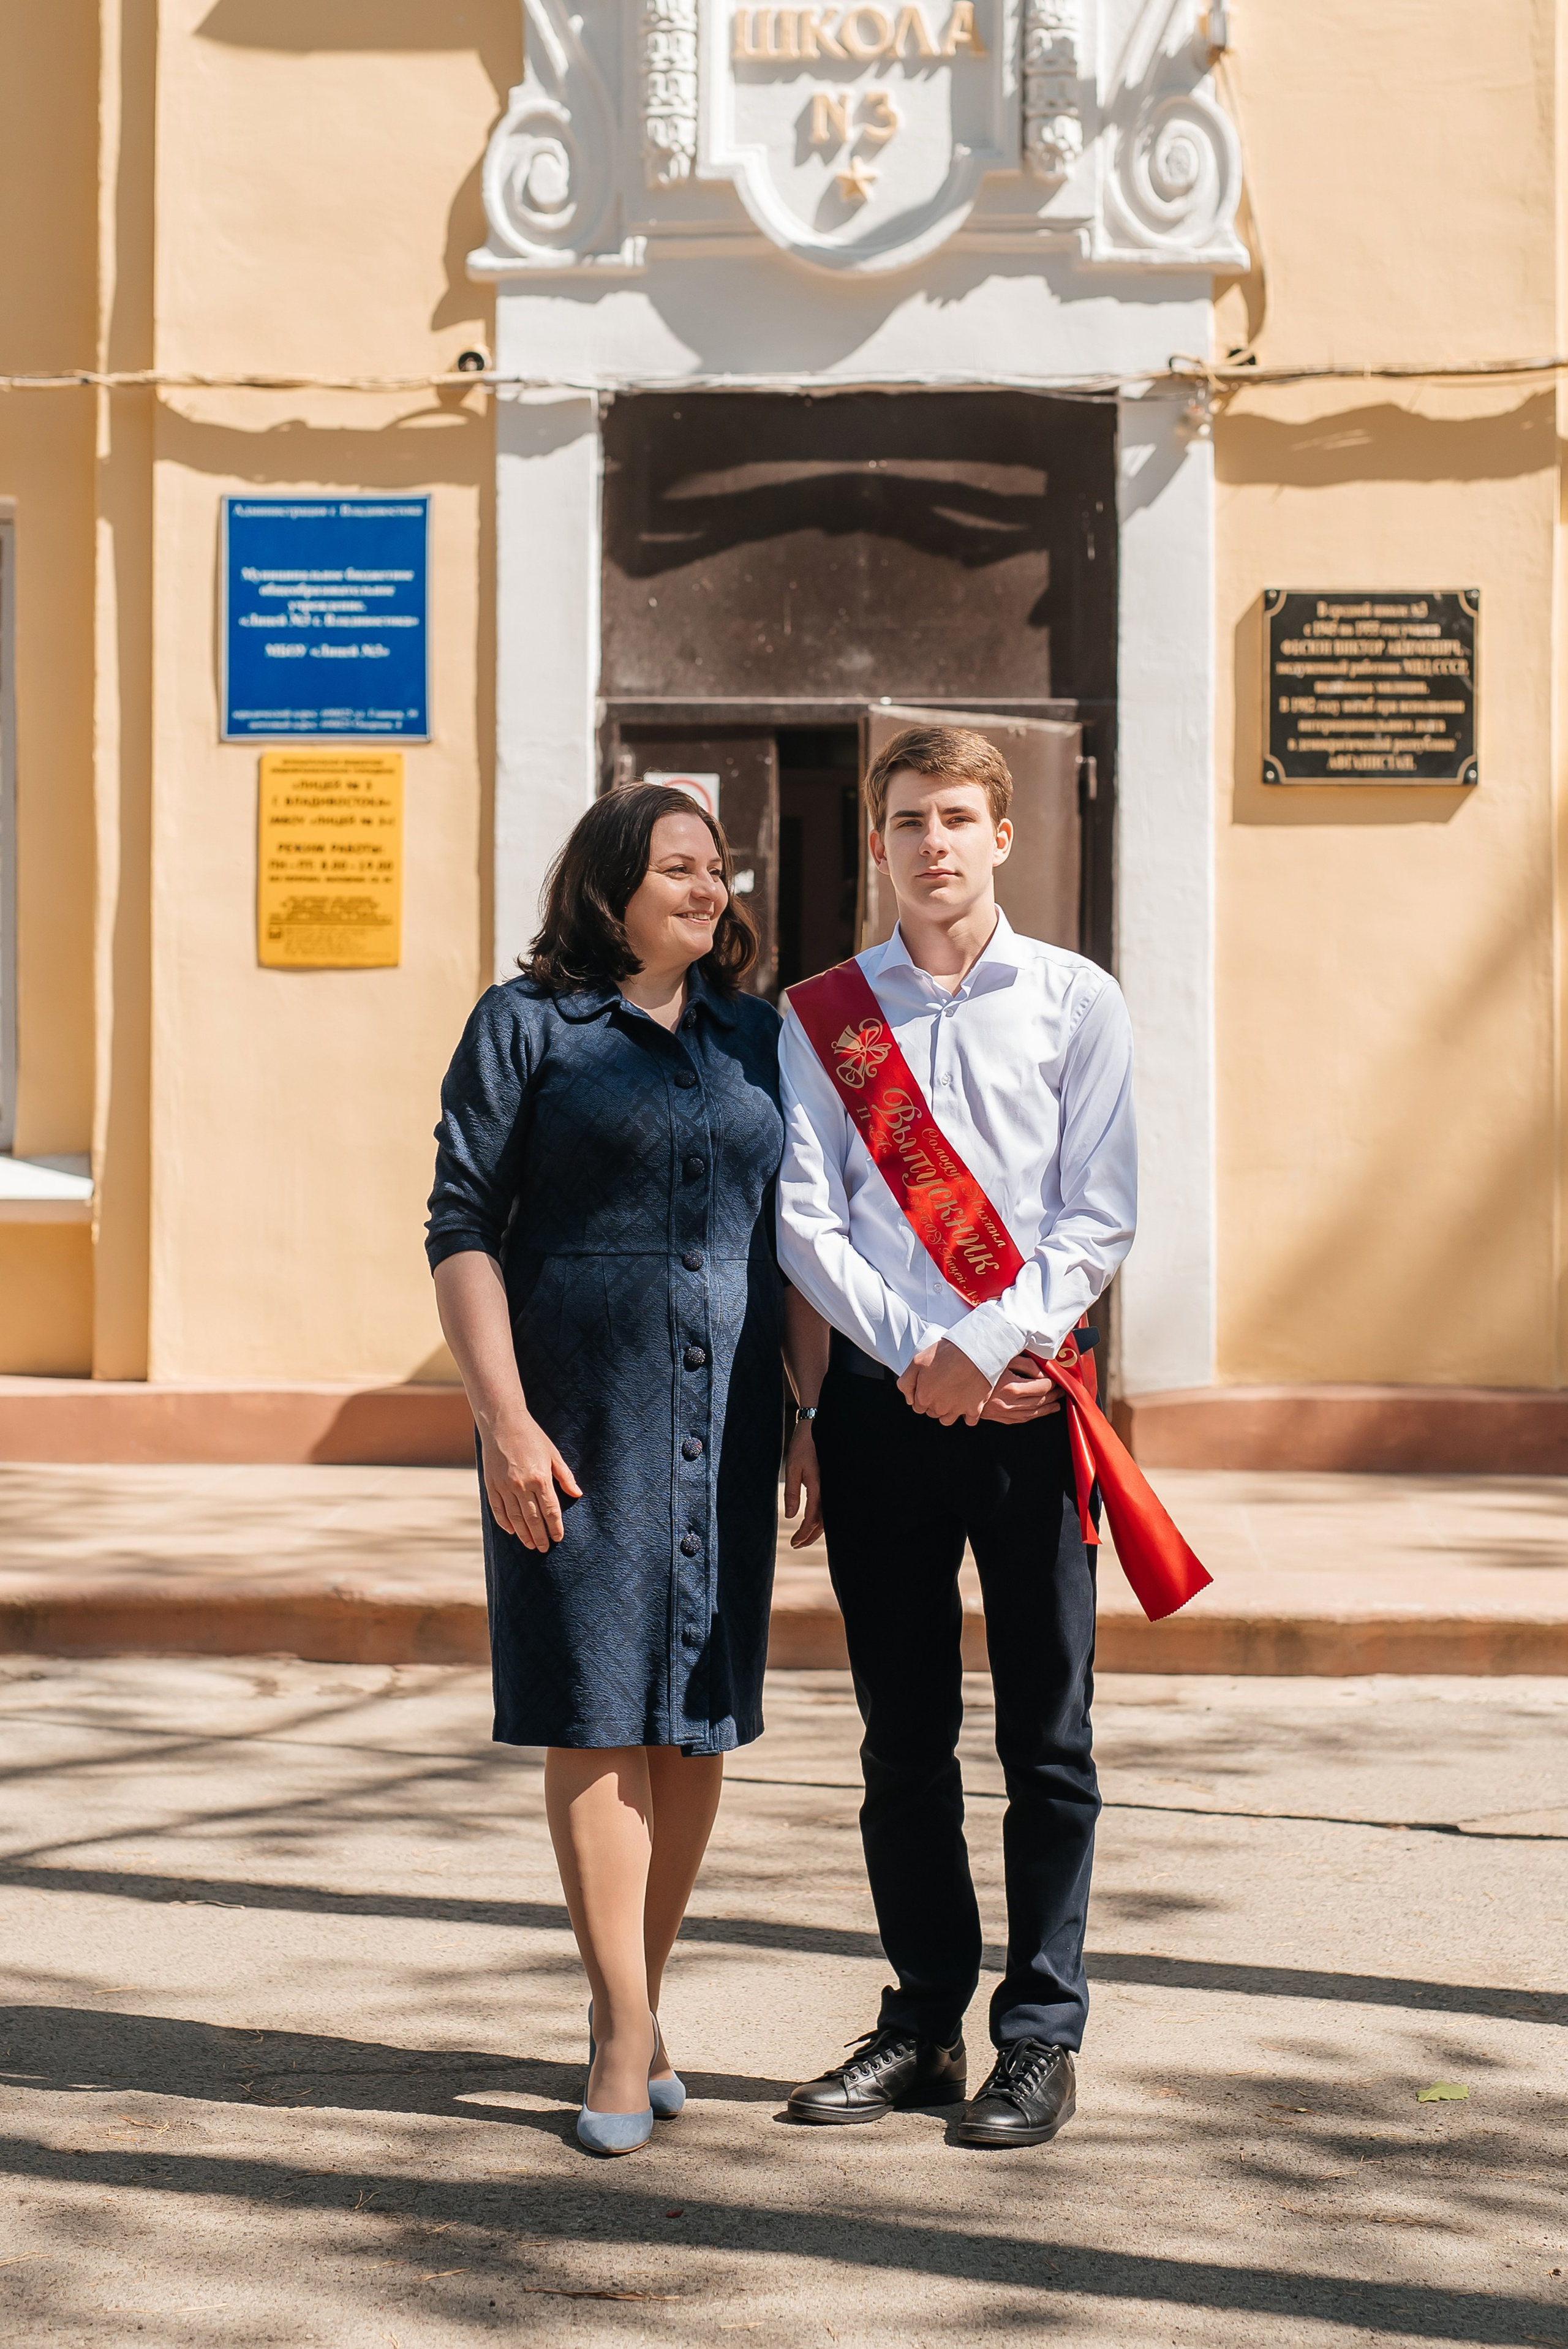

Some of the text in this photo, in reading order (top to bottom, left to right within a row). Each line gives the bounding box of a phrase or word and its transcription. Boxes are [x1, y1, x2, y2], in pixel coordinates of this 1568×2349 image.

[732, 2, 989, 59] ШКОЛА
[241, 567, 414, 584] Муниципальное бюджетное
[259, 582, 396, 598] общеобразовательное
[1317, 601, 1327, 617] В
[239, 613, 287, 627] «Лицей
[265, 643, 307, 658] МБОУ
[309, 643, 360, 658] «Лицей
[1333, 639, 1385, 656] ВИКТОР
[1279, 696, 1289, 713] В
[292, 780, 341, 792] «ЛИЦЕЙ
[285, 796, 392, 809] ВЛАДИВОСТОКА»
[309, 814, 356, 828] «ЛИЦЕЙ
[277, 843, 325, 854] РЕЖИМ
[856, 1105, 892, 1154] 11 «А»
[871, 1087, 1000, 1275] Выпускник
[962, 1186, 1006, 1248] Михаил
[938, 1247, 968, 1284] Лицей
